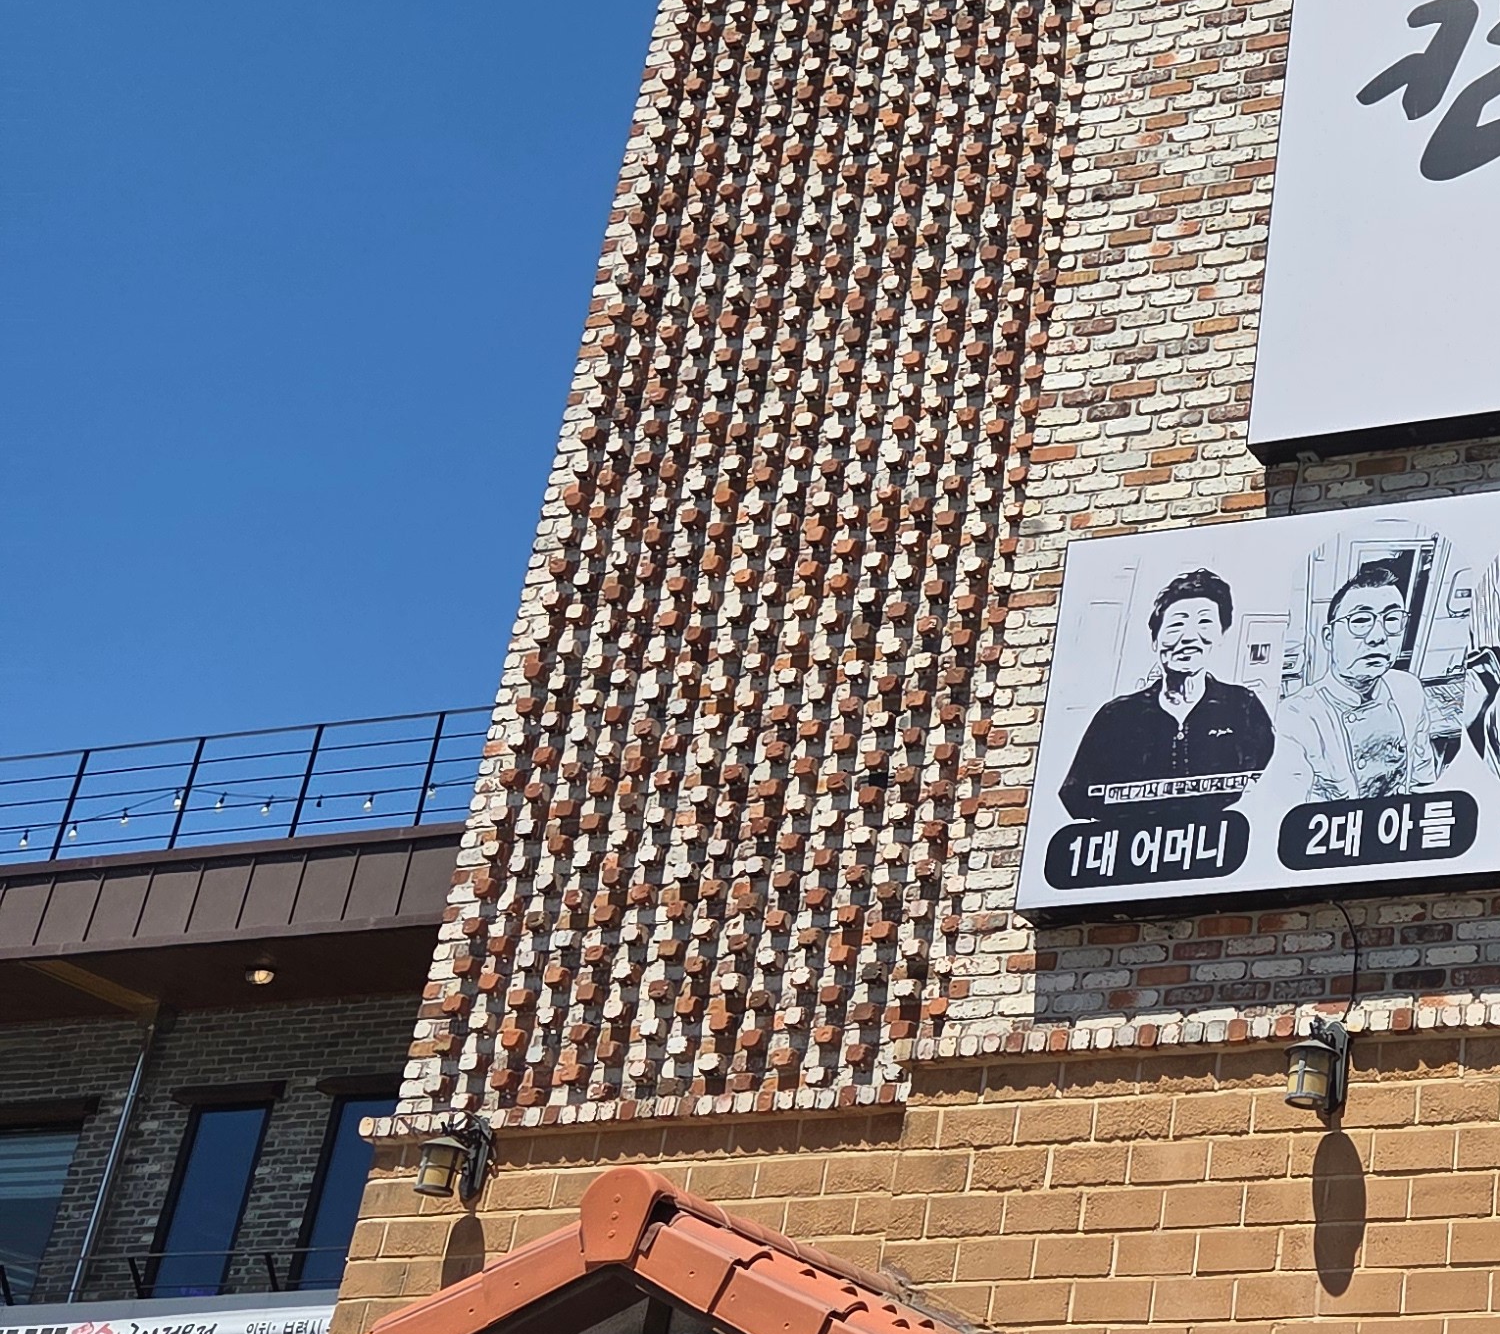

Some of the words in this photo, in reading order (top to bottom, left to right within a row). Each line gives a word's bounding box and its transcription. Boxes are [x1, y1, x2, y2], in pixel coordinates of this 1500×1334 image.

[1069, 829, 1120, 877] 1대
[1130, 819, 1229, 874] 어머니
[1305, 809, 1364, 857] 2대
[1377, 799, 1457, 851] 아들
